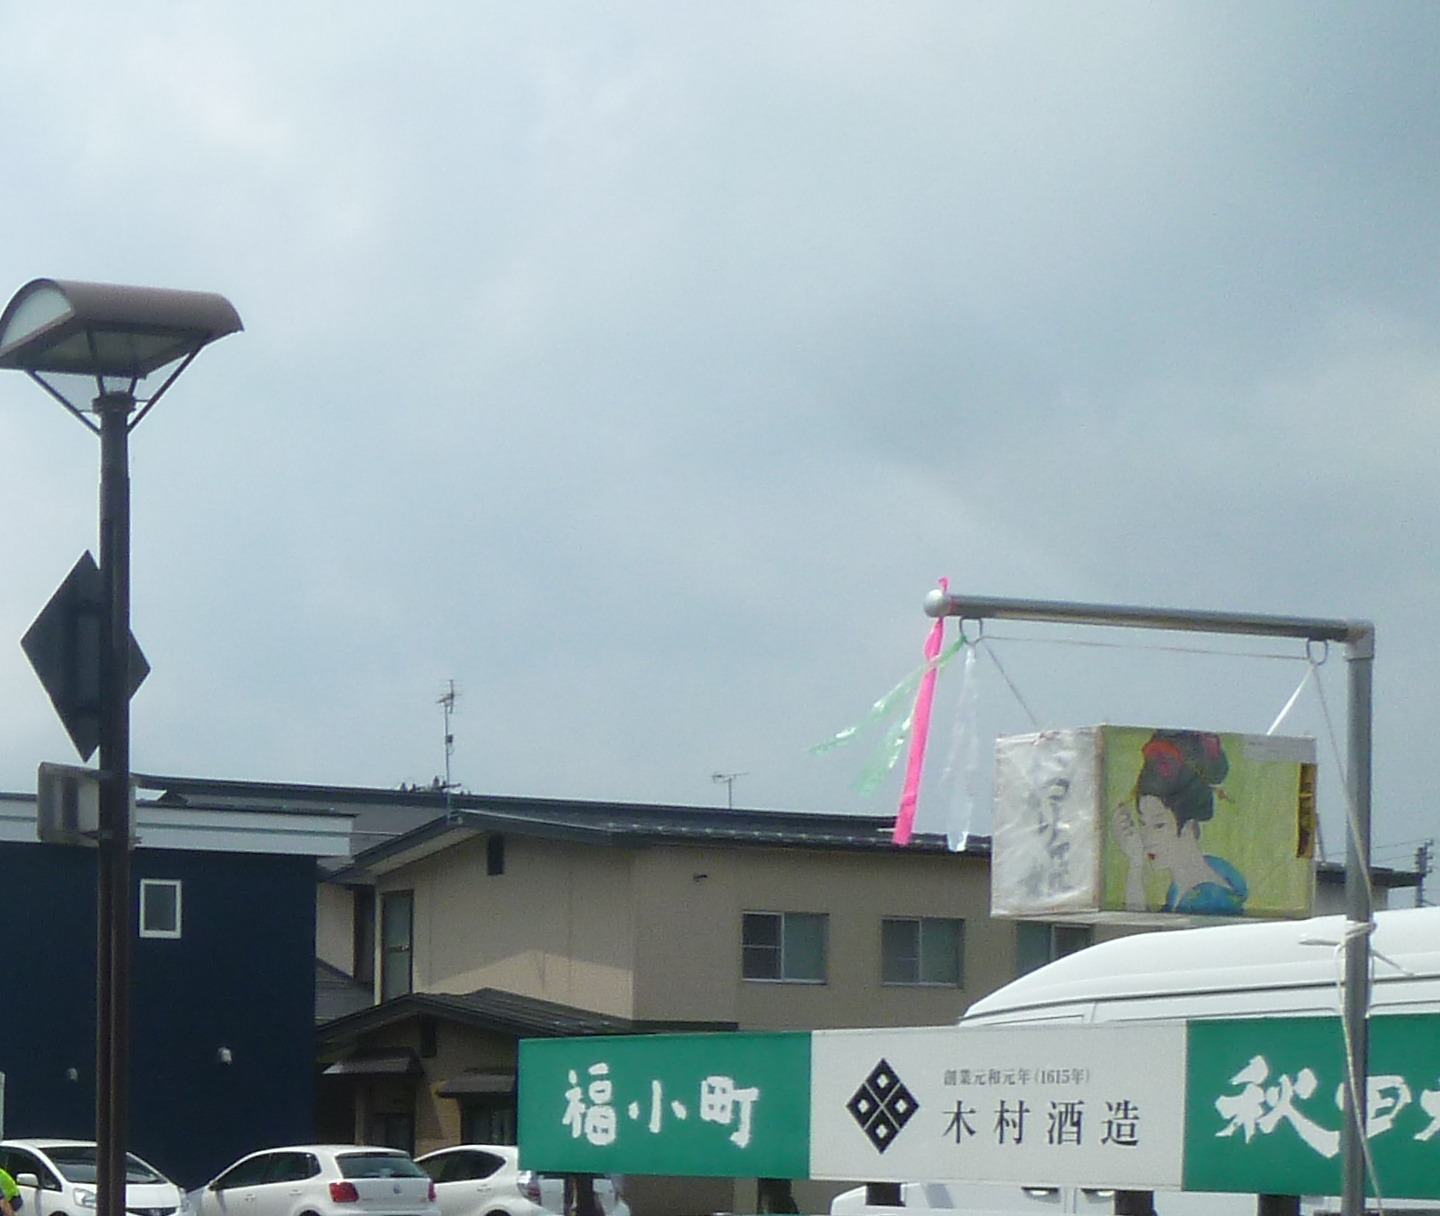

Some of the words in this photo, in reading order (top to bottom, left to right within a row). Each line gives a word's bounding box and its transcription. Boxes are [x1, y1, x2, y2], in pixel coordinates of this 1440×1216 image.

[561, 1061, 760, 1149] 福小町
[942, 1099, 1140, 1147] 木村酒造
